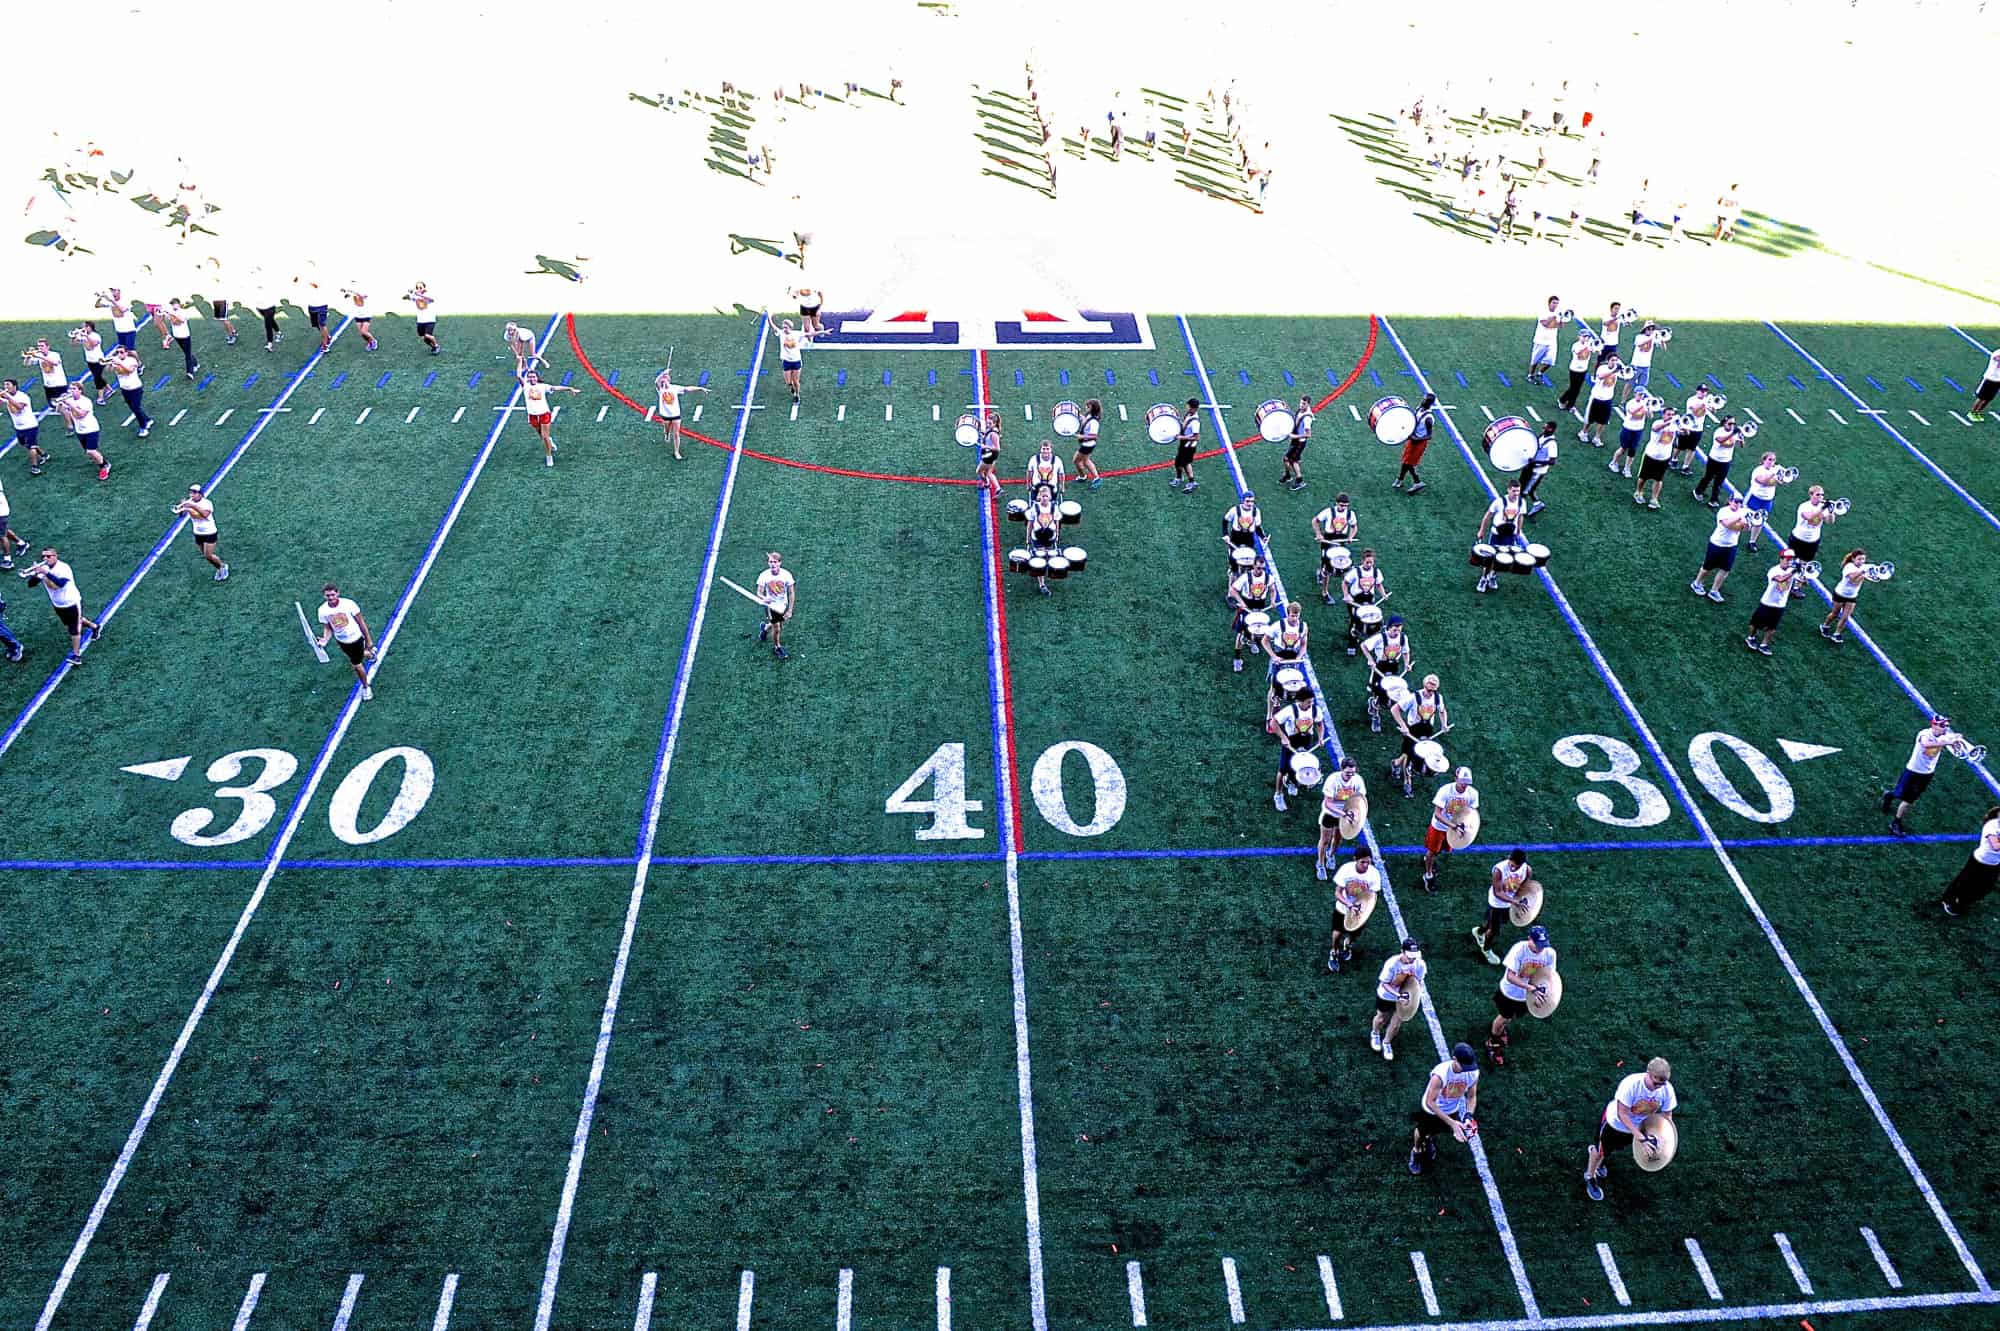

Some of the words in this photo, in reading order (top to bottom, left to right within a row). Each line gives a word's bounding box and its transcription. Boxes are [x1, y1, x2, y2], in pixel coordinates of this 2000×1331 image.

[170, 747, 435, 847] 30
[885, 740, 1127, 840] 40
[1552, 732, 1795, 827] 30
